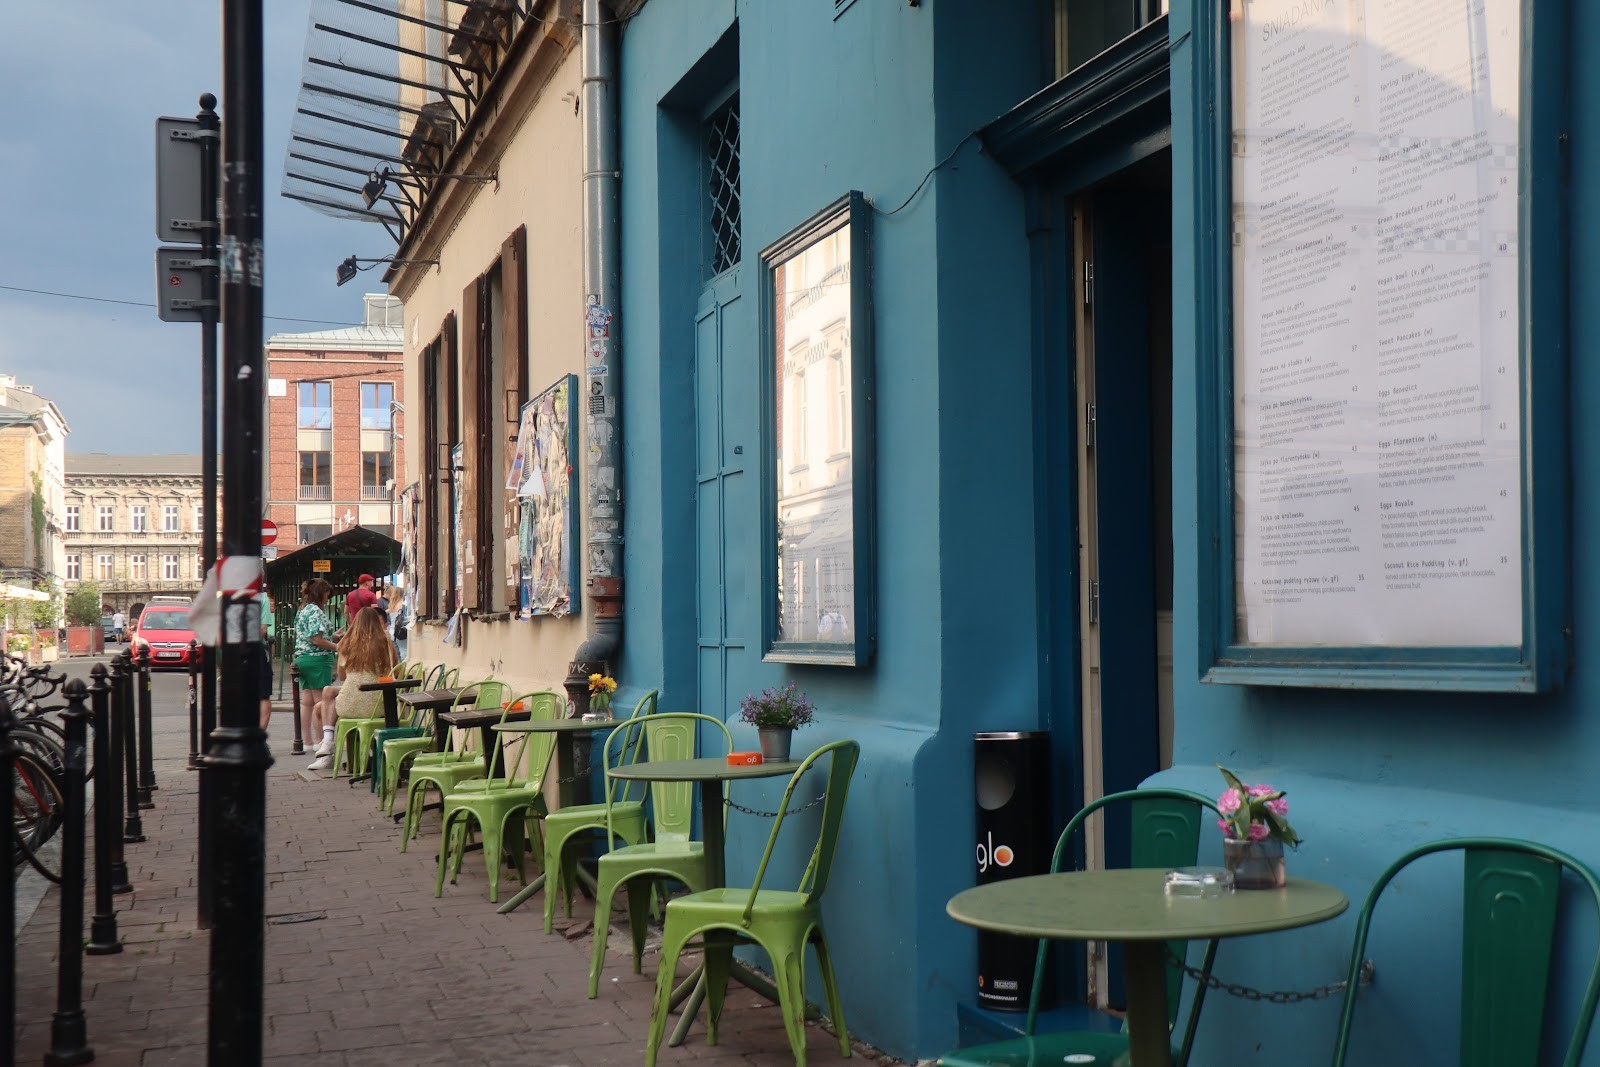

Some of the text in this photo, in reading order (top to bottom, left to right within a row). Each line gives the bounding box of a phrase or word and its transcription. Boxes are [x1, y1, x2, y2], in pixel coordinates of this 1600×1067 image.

[1380, 78, 1398, 92] Spring
[1402, 138, 1428, 153] Sandwich
[1378, 214, 1392, 224] Green
[1395, 203, 1423, 218] Breakfast
[1426, 197, 1442, 208] Plate
[1498, 243, 1508, 252] 40
[1377, 275, 1392, 286] Vegan
[1395, 271, 1407, 280] bowl
[1499, 310, 1507, 318] 37
[1378, 336, 1393, 346] Sweet
[1396, 330, 1420, 342] Pancakes
[1260, 366, 1279, 374] Pancakes
[1498, 366, 1506, 374] 43
[1378, 383, 1417, 398] Eggs Benedict
[1378, 439, 1390, 448] Eggs
[1393, 434, 1424, 445] Florentine
[1380, 499, 1414, 510] Eggs Royale
[1421, 559, 1444, 567] Pudding
[1284, 577, 1302, 585] pudding
[976, 830, 1014, 873] glo
